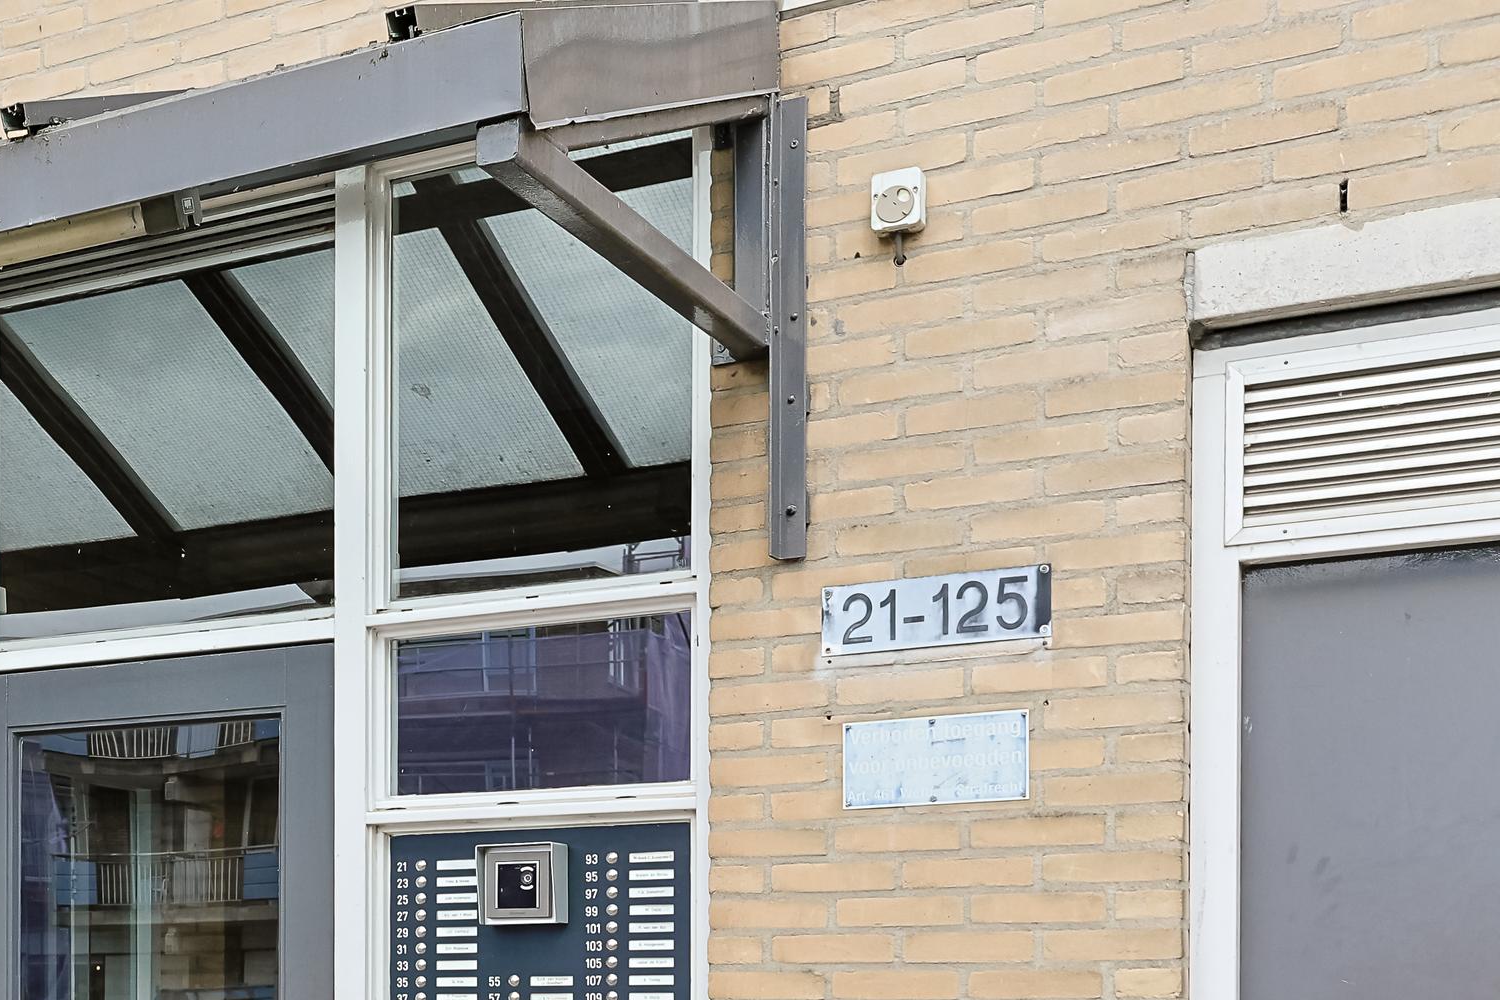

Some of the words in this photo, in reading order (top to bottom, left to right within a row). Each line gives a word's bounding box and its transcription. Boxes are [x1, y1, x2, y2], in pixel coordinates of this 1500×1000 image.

[842, 575, 1028, 645] 21-125
[944, 719, 1021, 738] toegang
[585, 853, 599, 865] 93
[396, 861, 407, 873] 21
[585, 870, 599, 883] 95
[396, 878, 409, 889] 23
[396, 894, 409, 906] 25
[585, 888, 598, 900] 97
[396, 910, 409, 922] 27
[584, 905, 599, 917] 99
[396, 927, 409, 939] 29
[585, 922, 601, 935] 101
[396, 944, 407, 955] 31
[585, 940, 603, 952] 103
[396, 960, 409, 972] 33
[585, 957, 603, 969] 105
[396, 976, 409, 988] 35
[488, 976, 501, 988] 55
[585, 974, 603, 987] 107
